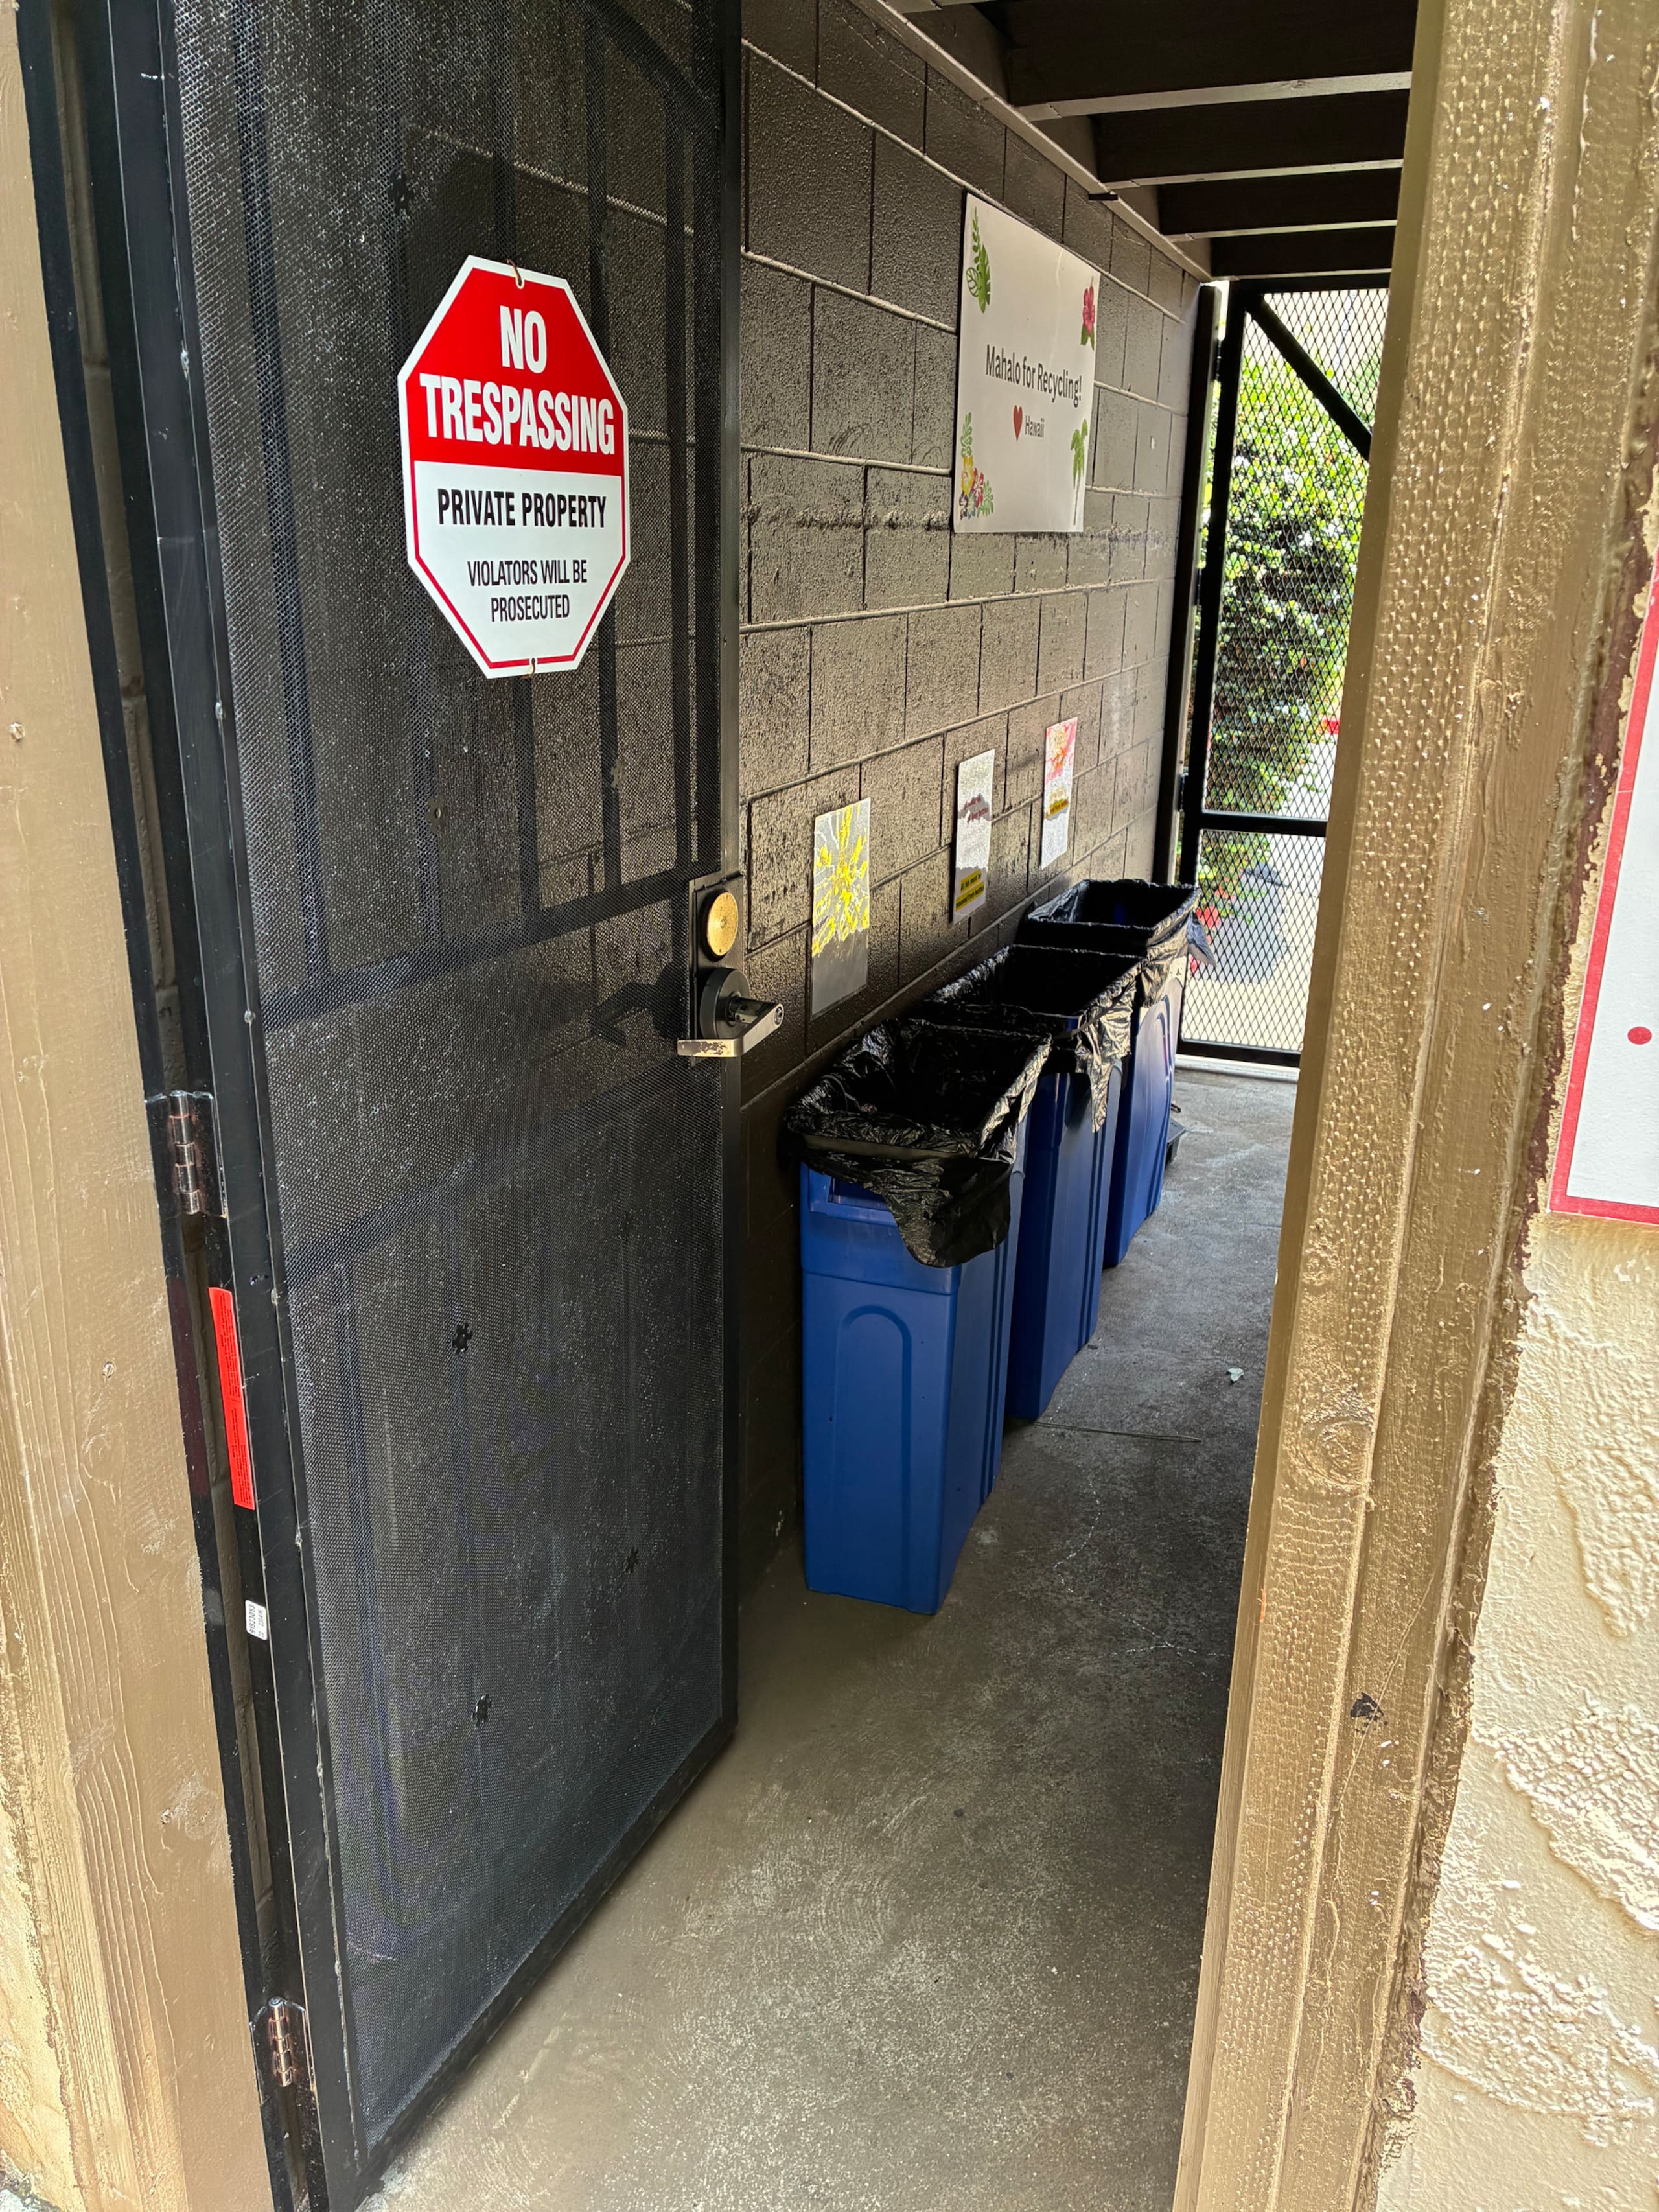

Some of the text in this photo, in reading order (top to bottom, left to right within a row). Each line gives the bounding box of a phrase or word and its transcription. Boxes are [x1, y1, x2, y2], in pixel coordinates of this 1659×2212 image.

[500, 305, 547, 374] NO
[986, 344, 1082, 408] Mahalo for Recycling!
[419, 373, 615, 455] TRESPASSING
[1025, 415, 1045, 438] Hawaii
[438, 489, 607, 528] PRIVATE PROPERTY
[467, 559, 588, 587] VIOLATORS WILL BE
[491, 594, 570, 623] PROSECUTED
